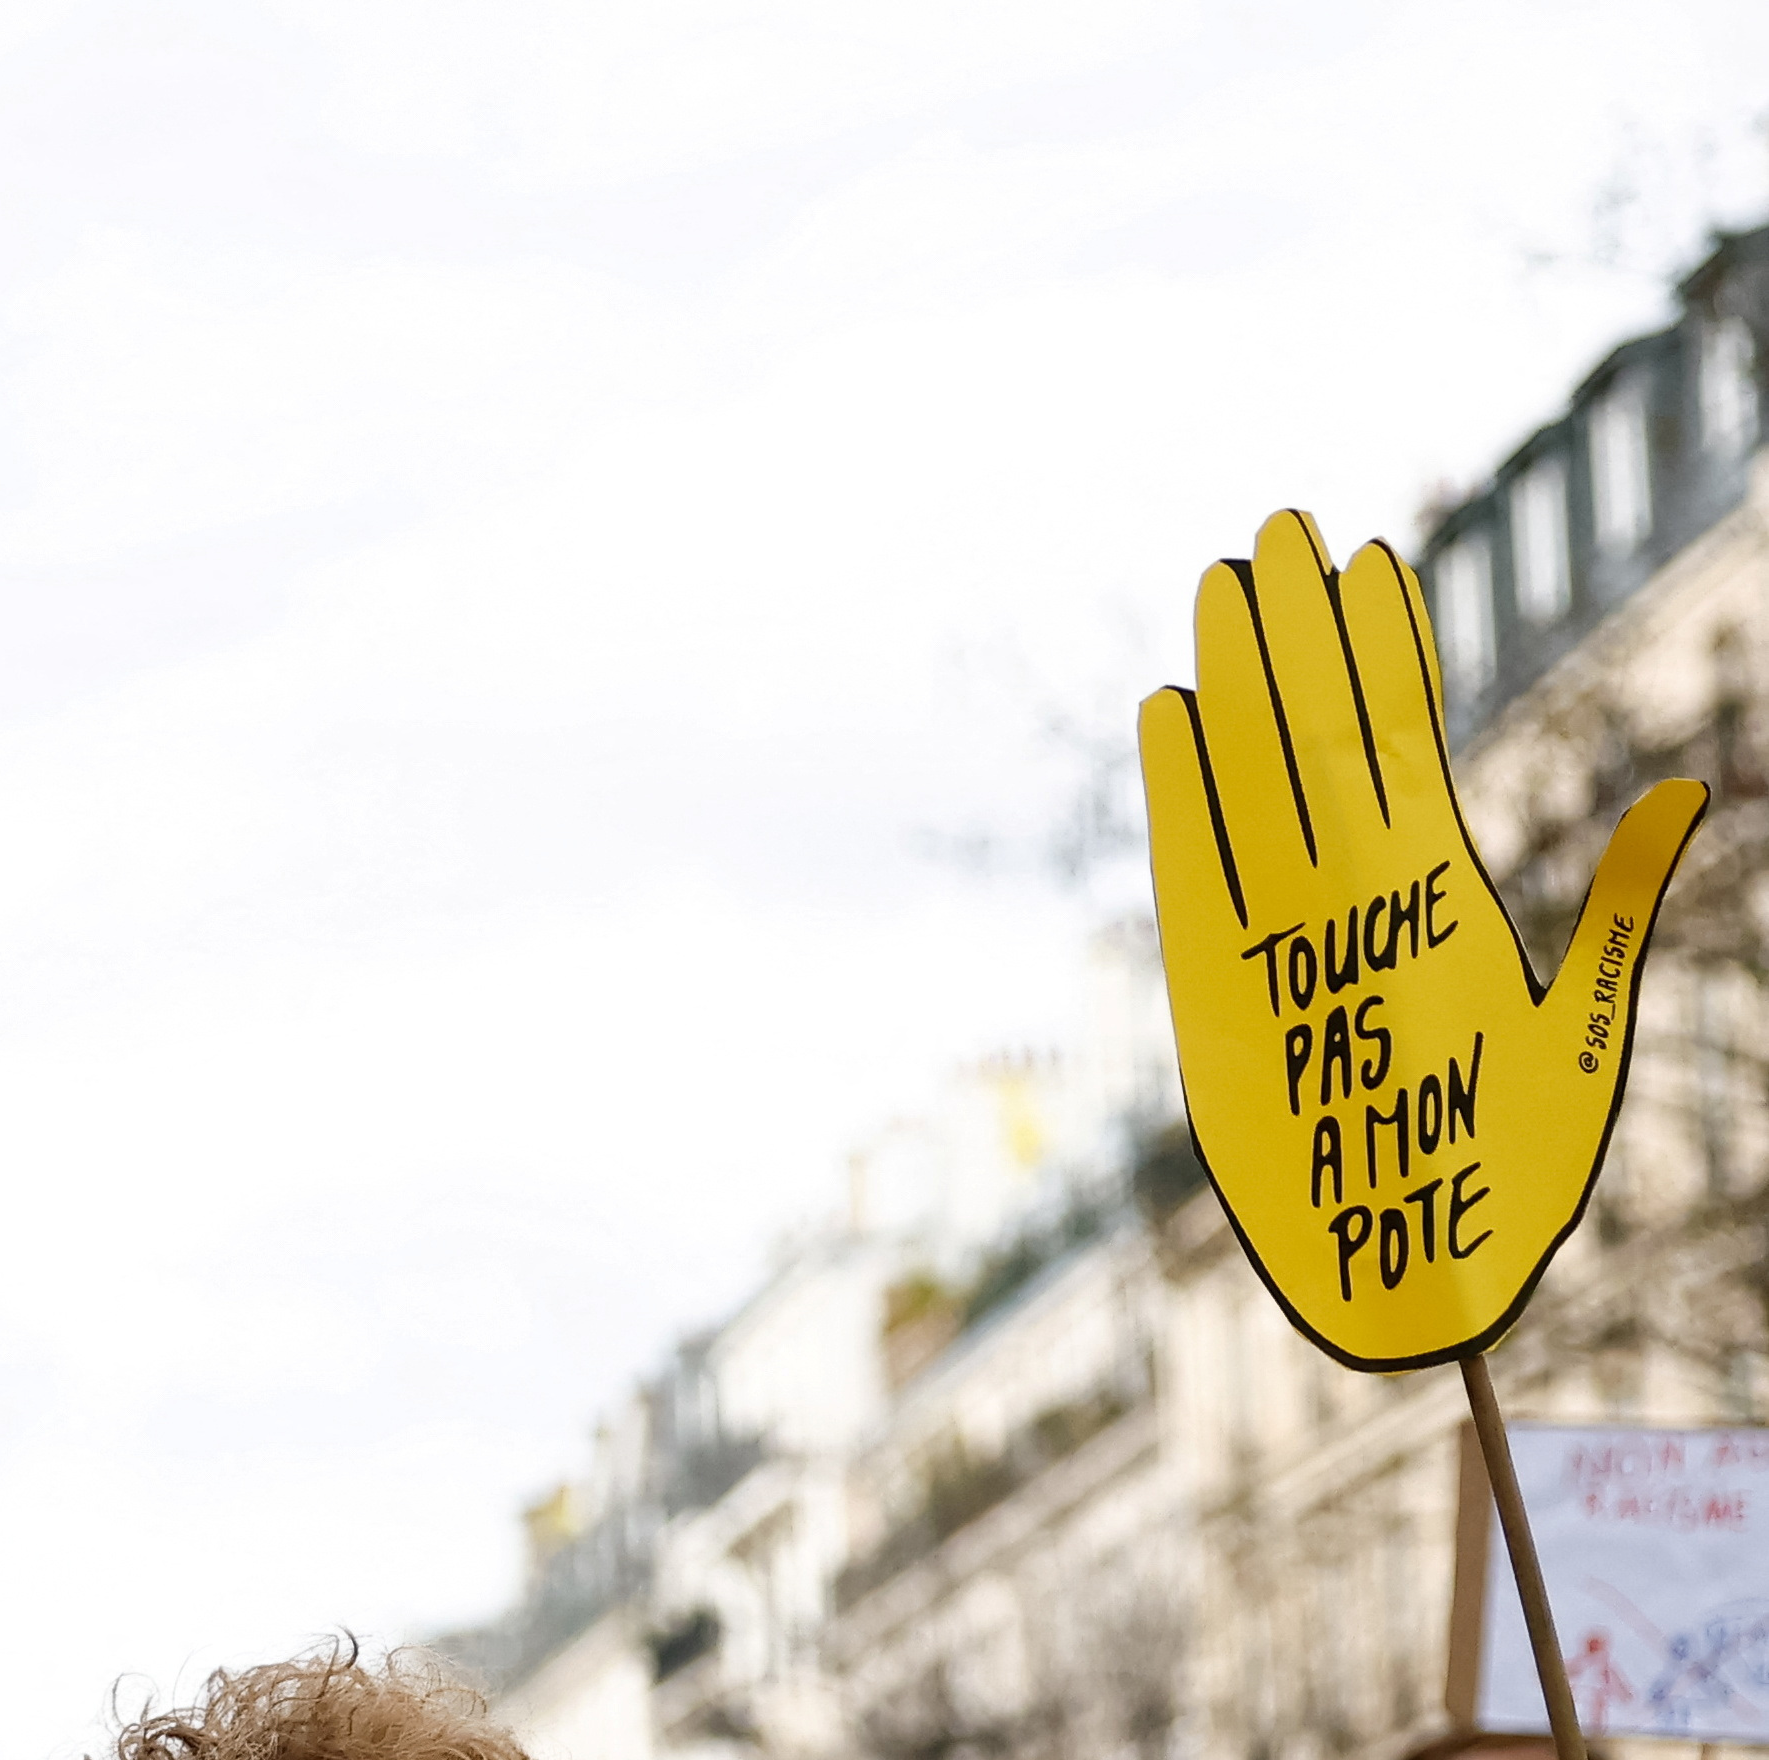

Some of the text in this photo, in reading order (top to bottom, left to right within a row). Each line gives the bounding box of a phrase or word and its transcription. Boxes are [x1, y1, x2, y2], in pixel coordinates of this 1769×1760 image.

[1241, 860, 1458, 1017] TOUCHE
[1577, 913, 1635, 1075] @SOS_RACISME
[1285, 995, 1392, 1116] PAS
[1311, 1031, 1484, 1208] A MON
[1328, 1162, 1494, 1302] POTE
